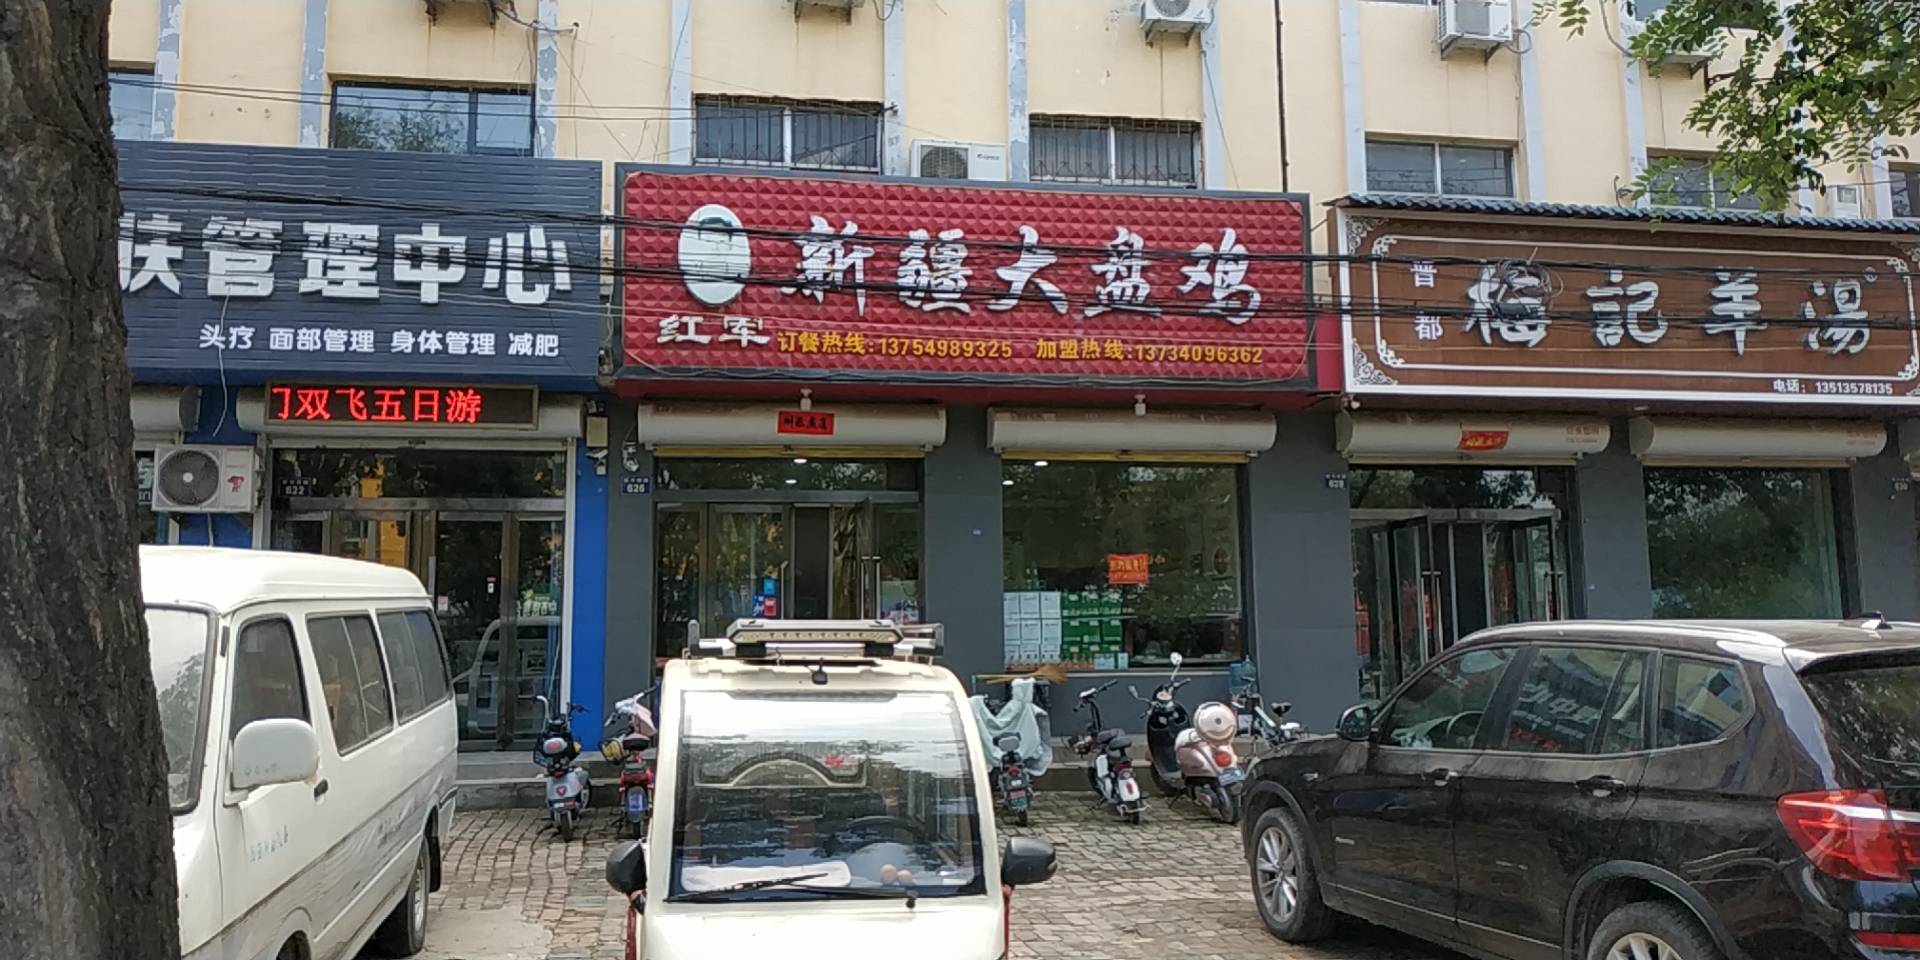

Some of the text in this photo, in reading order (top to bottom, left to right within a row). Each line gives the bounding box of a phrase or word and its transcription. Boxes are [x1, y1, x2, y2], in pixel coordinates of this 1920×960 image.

[780, 214, 1262, 325] 新疆大盘鸡
[200, 324, 560, 357] 头疗 面部管理 身体管理 减肥
[656, 314, 770, 347] 红军
[1815, 381, 1894, 395] 13513578135
[627, 484, 645, 493] 626
